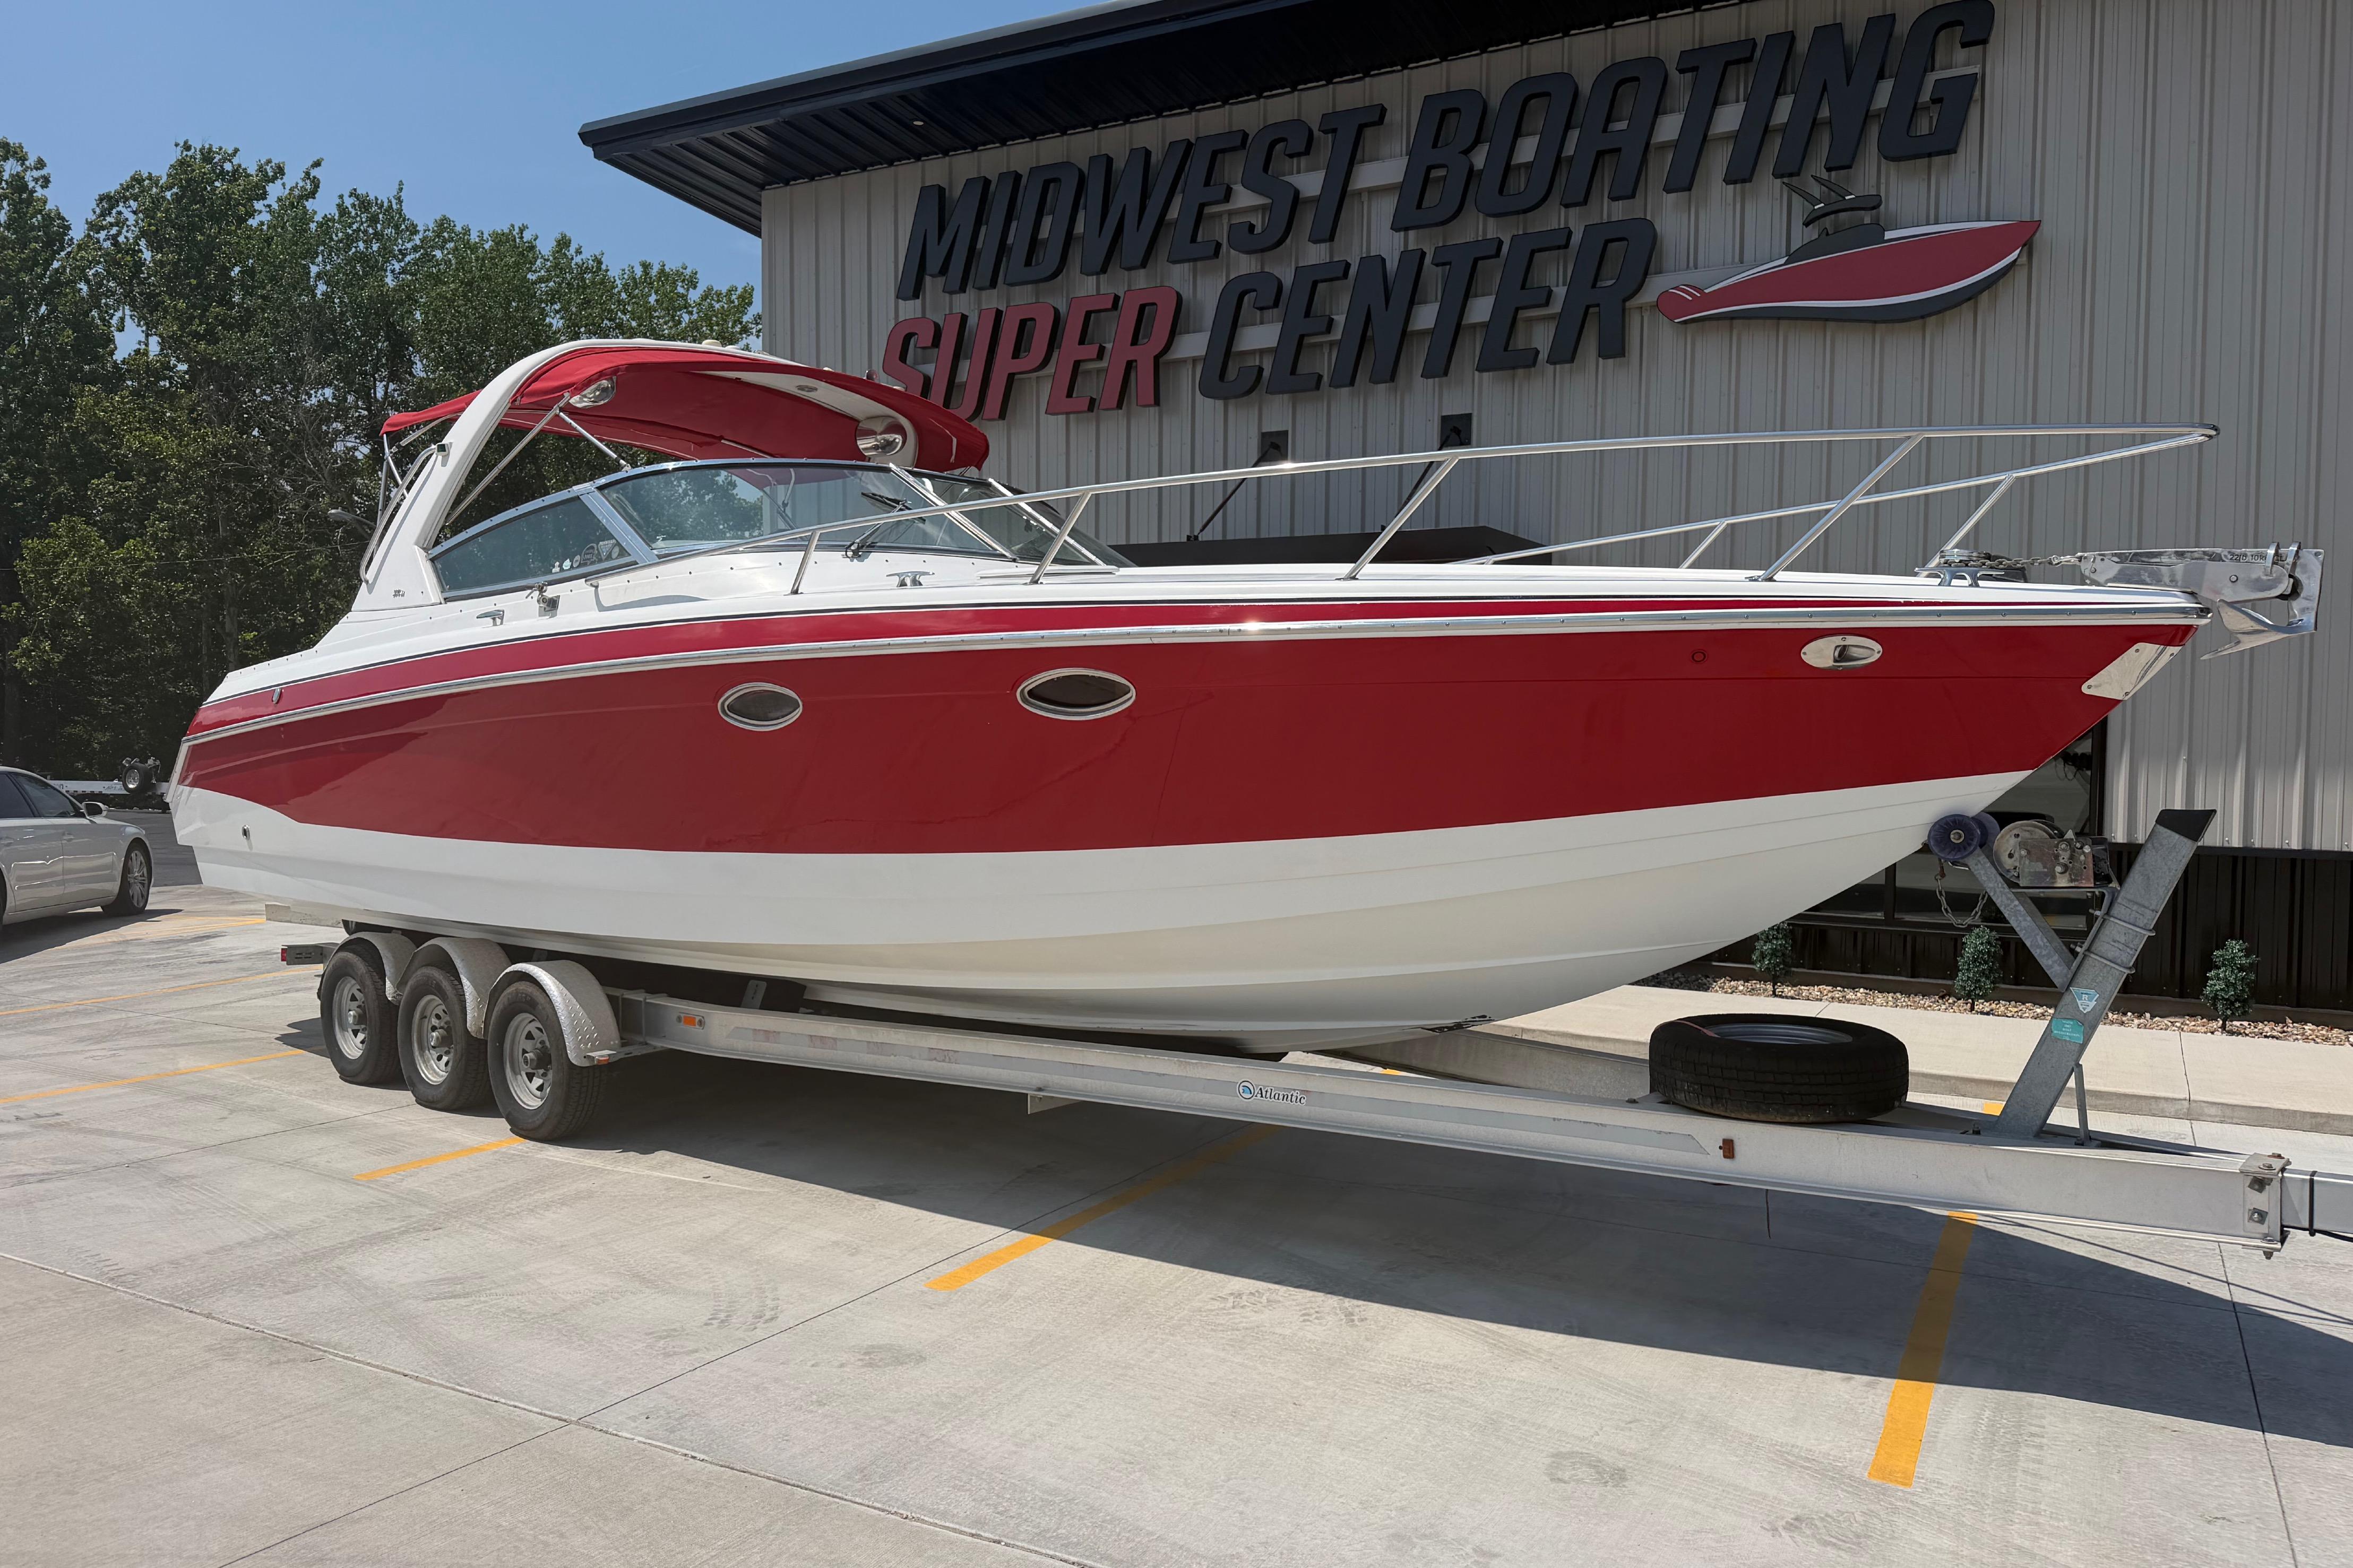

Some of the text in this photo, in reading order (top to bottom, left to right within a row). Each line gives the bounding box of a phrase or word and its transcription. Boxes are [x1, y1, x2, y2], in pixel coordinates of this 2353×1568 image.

[897, 0, 1995, 301] MIDWEST BOATING
[882, 218, 1658, 421] SUPER CENTER
[1254, 1087, 1305, 1105] Atlantic
